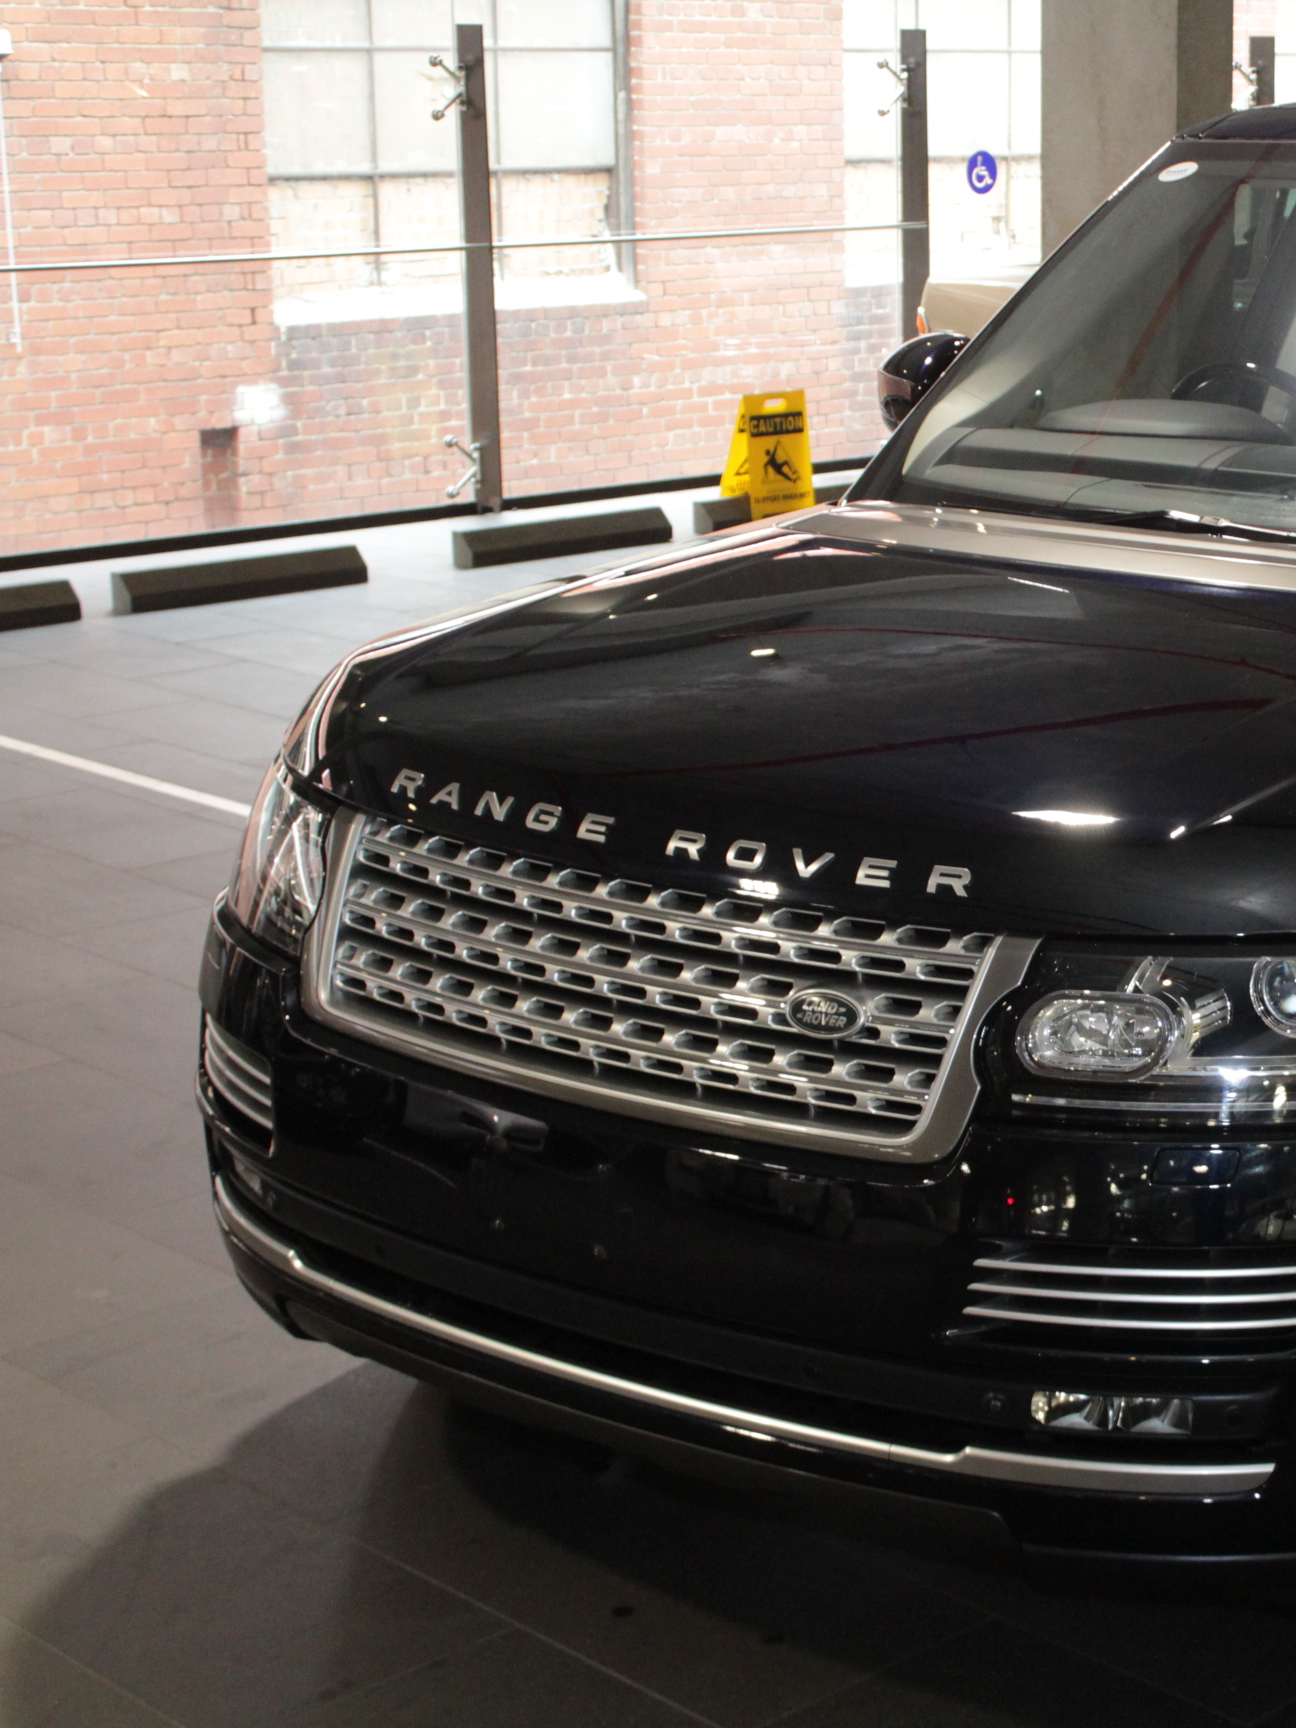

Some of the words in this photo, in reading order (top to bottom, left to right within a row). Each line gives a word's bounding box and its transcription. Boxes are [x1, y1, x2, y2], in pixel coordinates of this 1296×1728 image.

[750, 415, 803, 434] CAUTION
[390, 768, 615, 843] RANGE
[665, 828, 973, 898] ROVER
[802, 999, 838, 1014] LAND
[803, 1011, 847, 1028] ROVER
